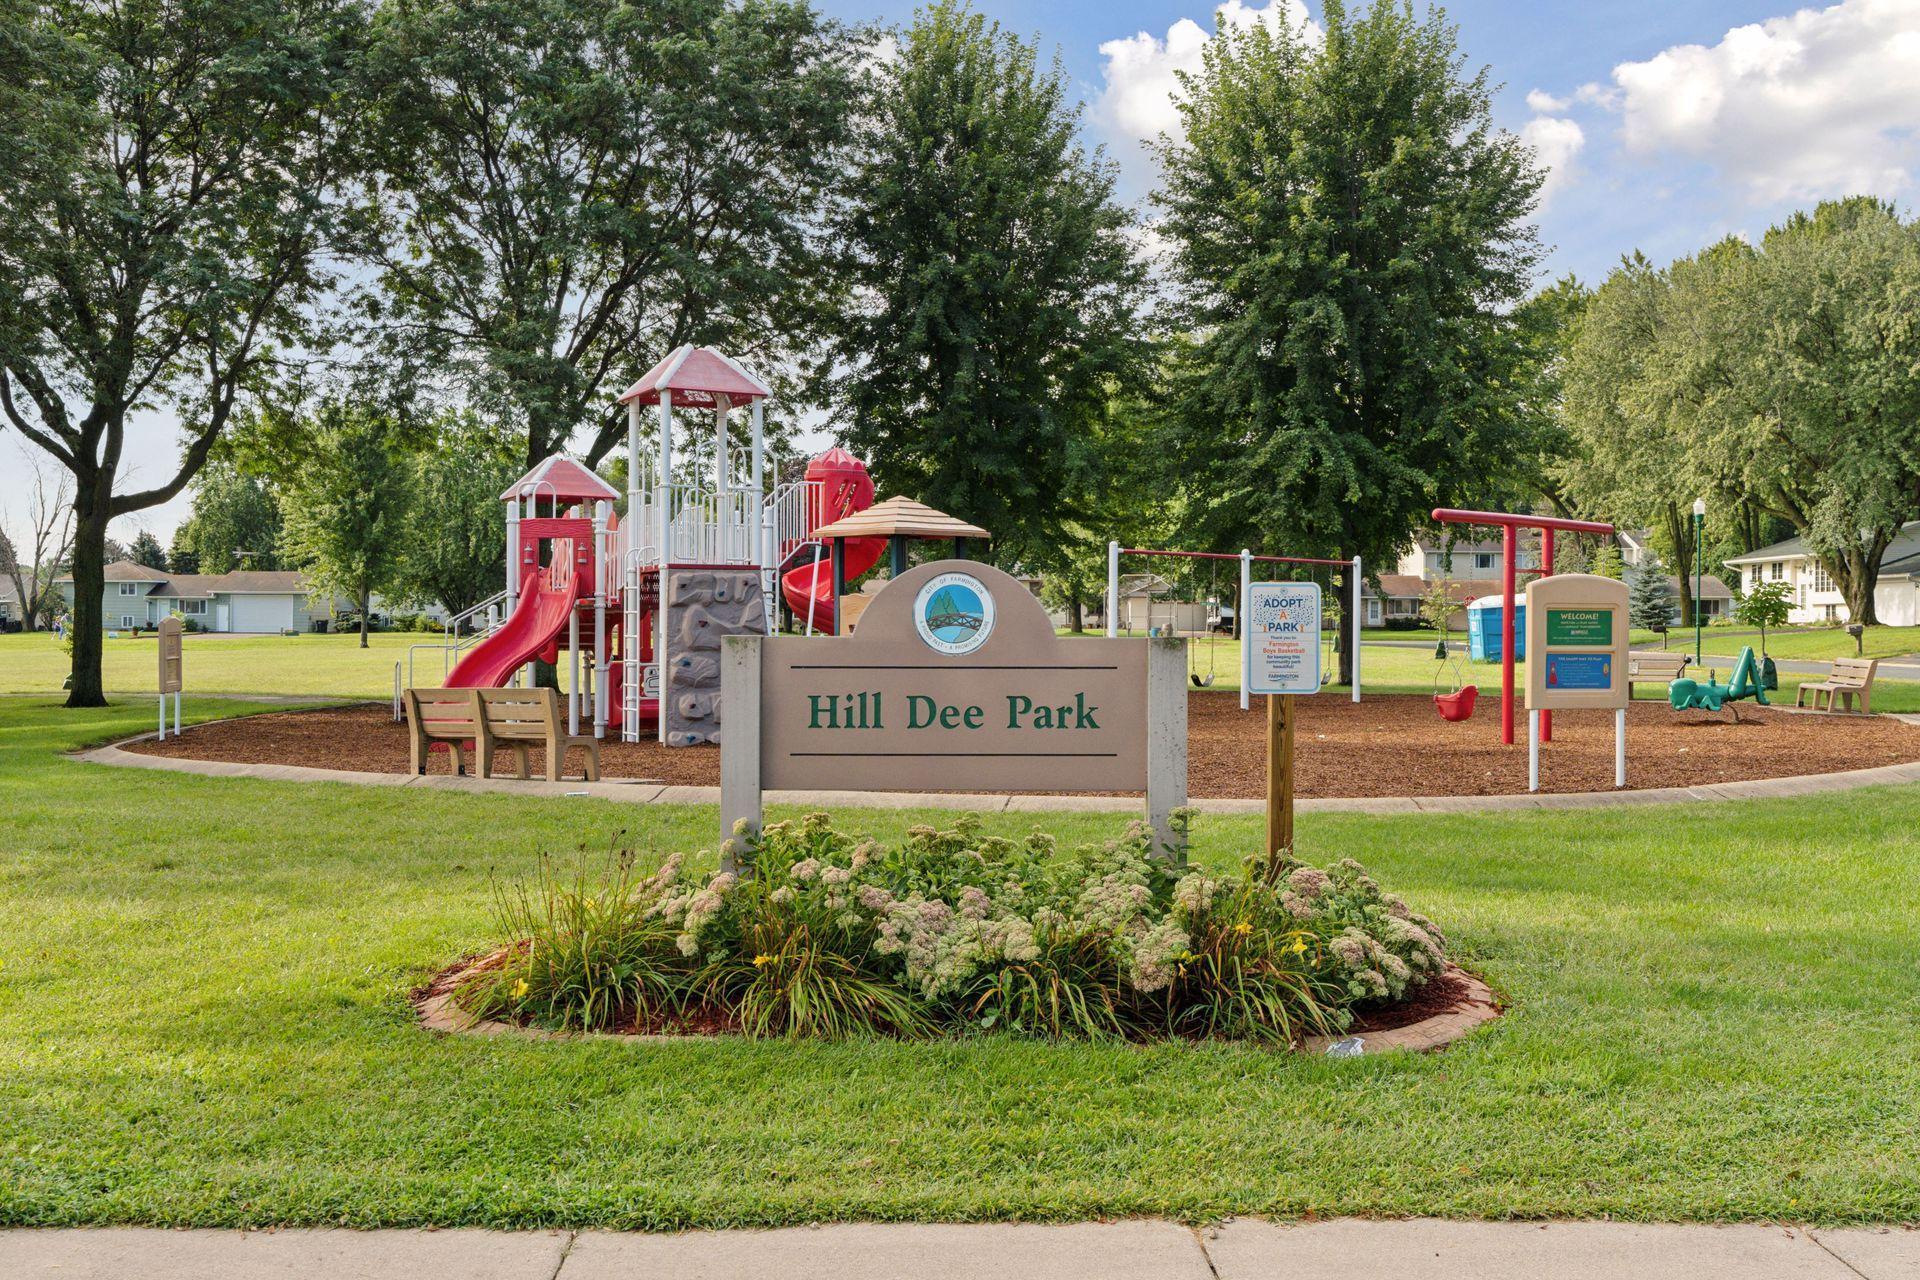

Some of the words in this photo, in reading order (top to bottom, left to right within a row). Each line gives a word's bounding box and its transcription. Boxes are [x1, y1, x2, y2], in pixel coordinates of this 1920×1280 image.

[925, 583, 937, 594] CITY
[950, 577, 984, 595] FARMINGTON
[1263, 599, 1303, 608] ADOPT
[1279, 611, 1287, 620] A
[1268, 622, 1299, 632] PARK
[807, 691, 884, 729] Hill
[906, 695, 984, 730] Dee
[1007, 692, 1100, 730] Park
